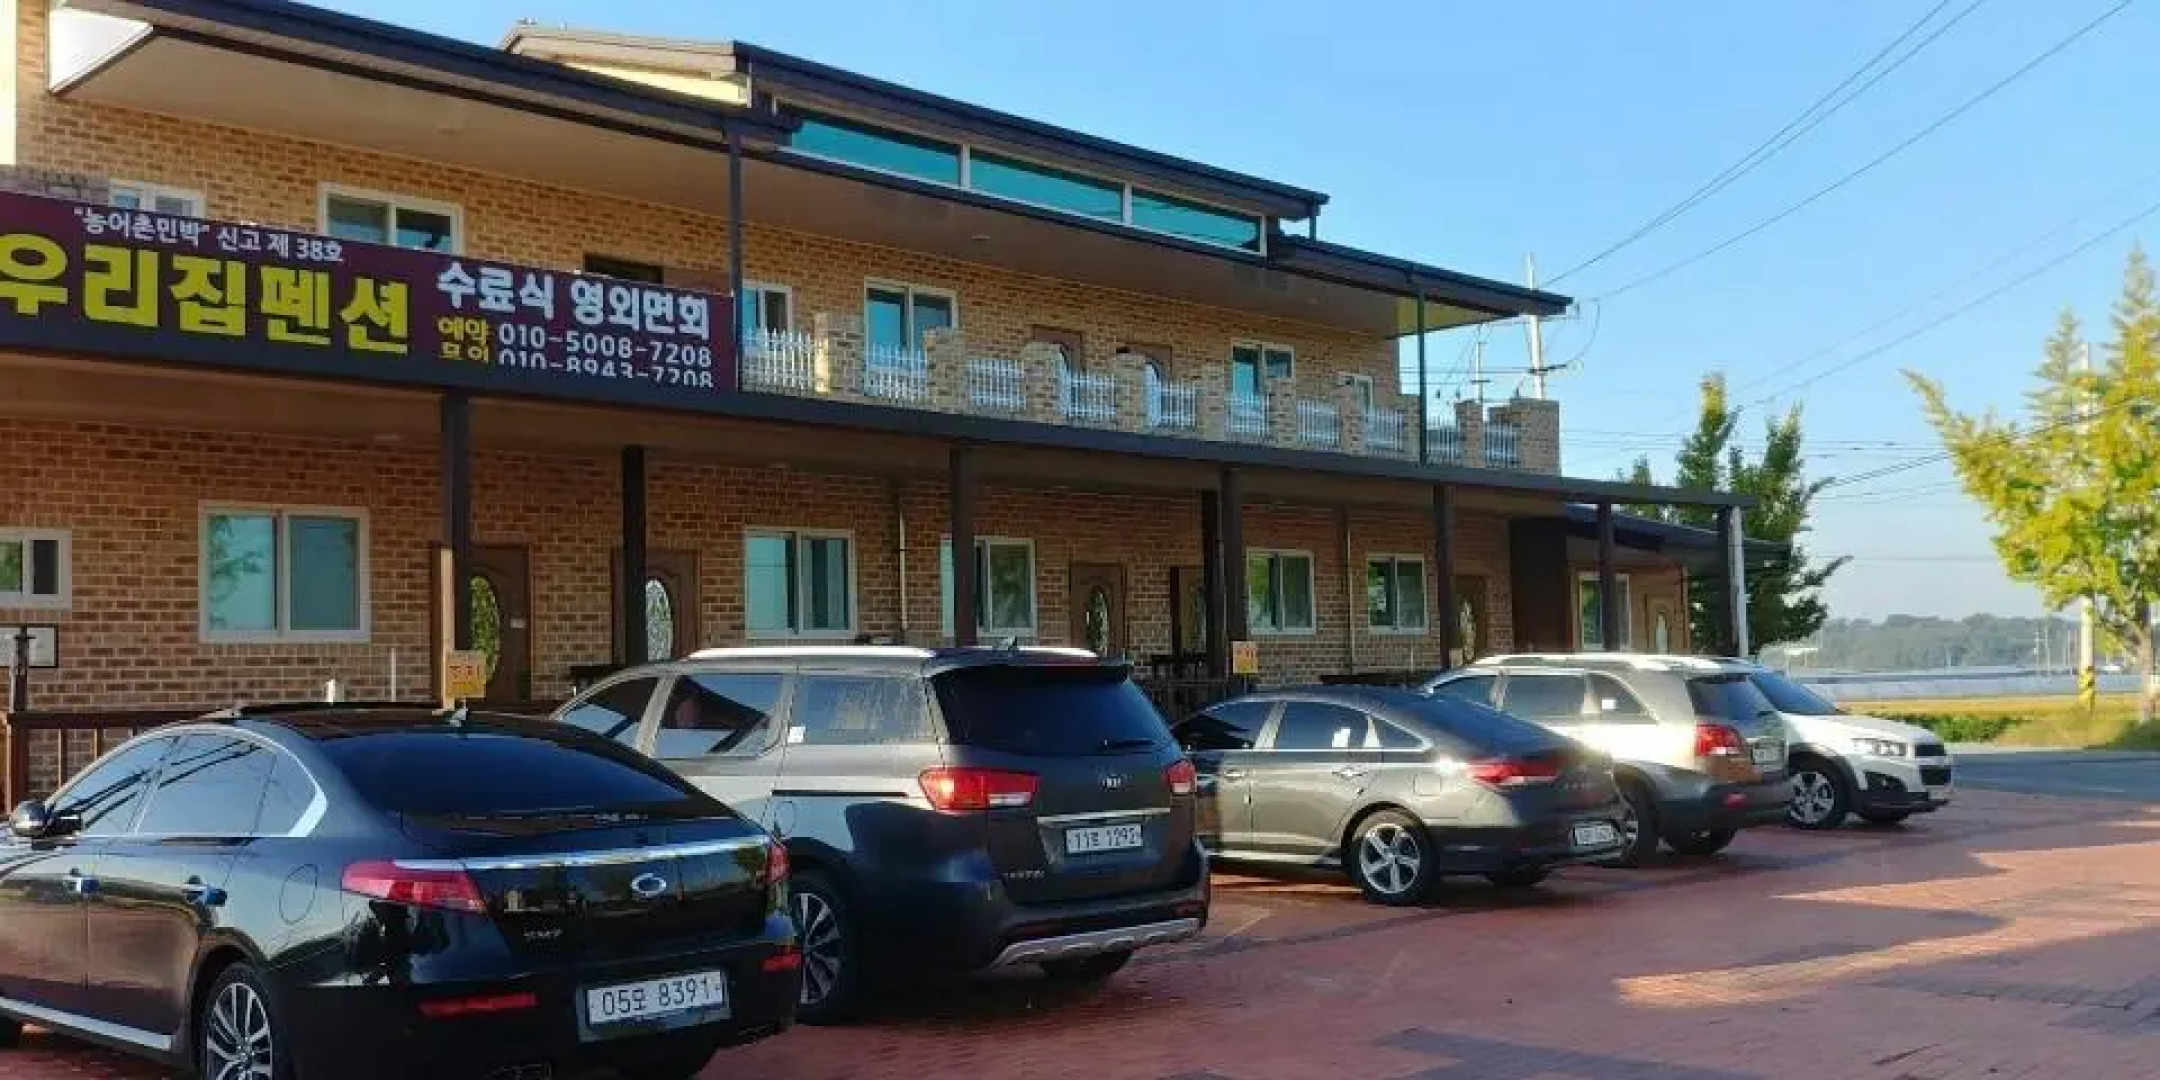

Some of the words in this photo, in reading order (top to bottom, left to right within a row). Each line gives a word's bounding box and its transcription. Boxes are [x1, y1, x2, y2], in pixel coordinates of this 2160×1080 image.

[217, 226, 262, 252] 신고
[268, 233, 289, 259] 제
[296, 238, 344, 262] 38호
[437, 261, 554, 320] 수료식
[571, 278, 710, 340] 영외면회
[499, 323, 712, 367] 010-5008-7208
[658, 976, 711, 1007] 8391
